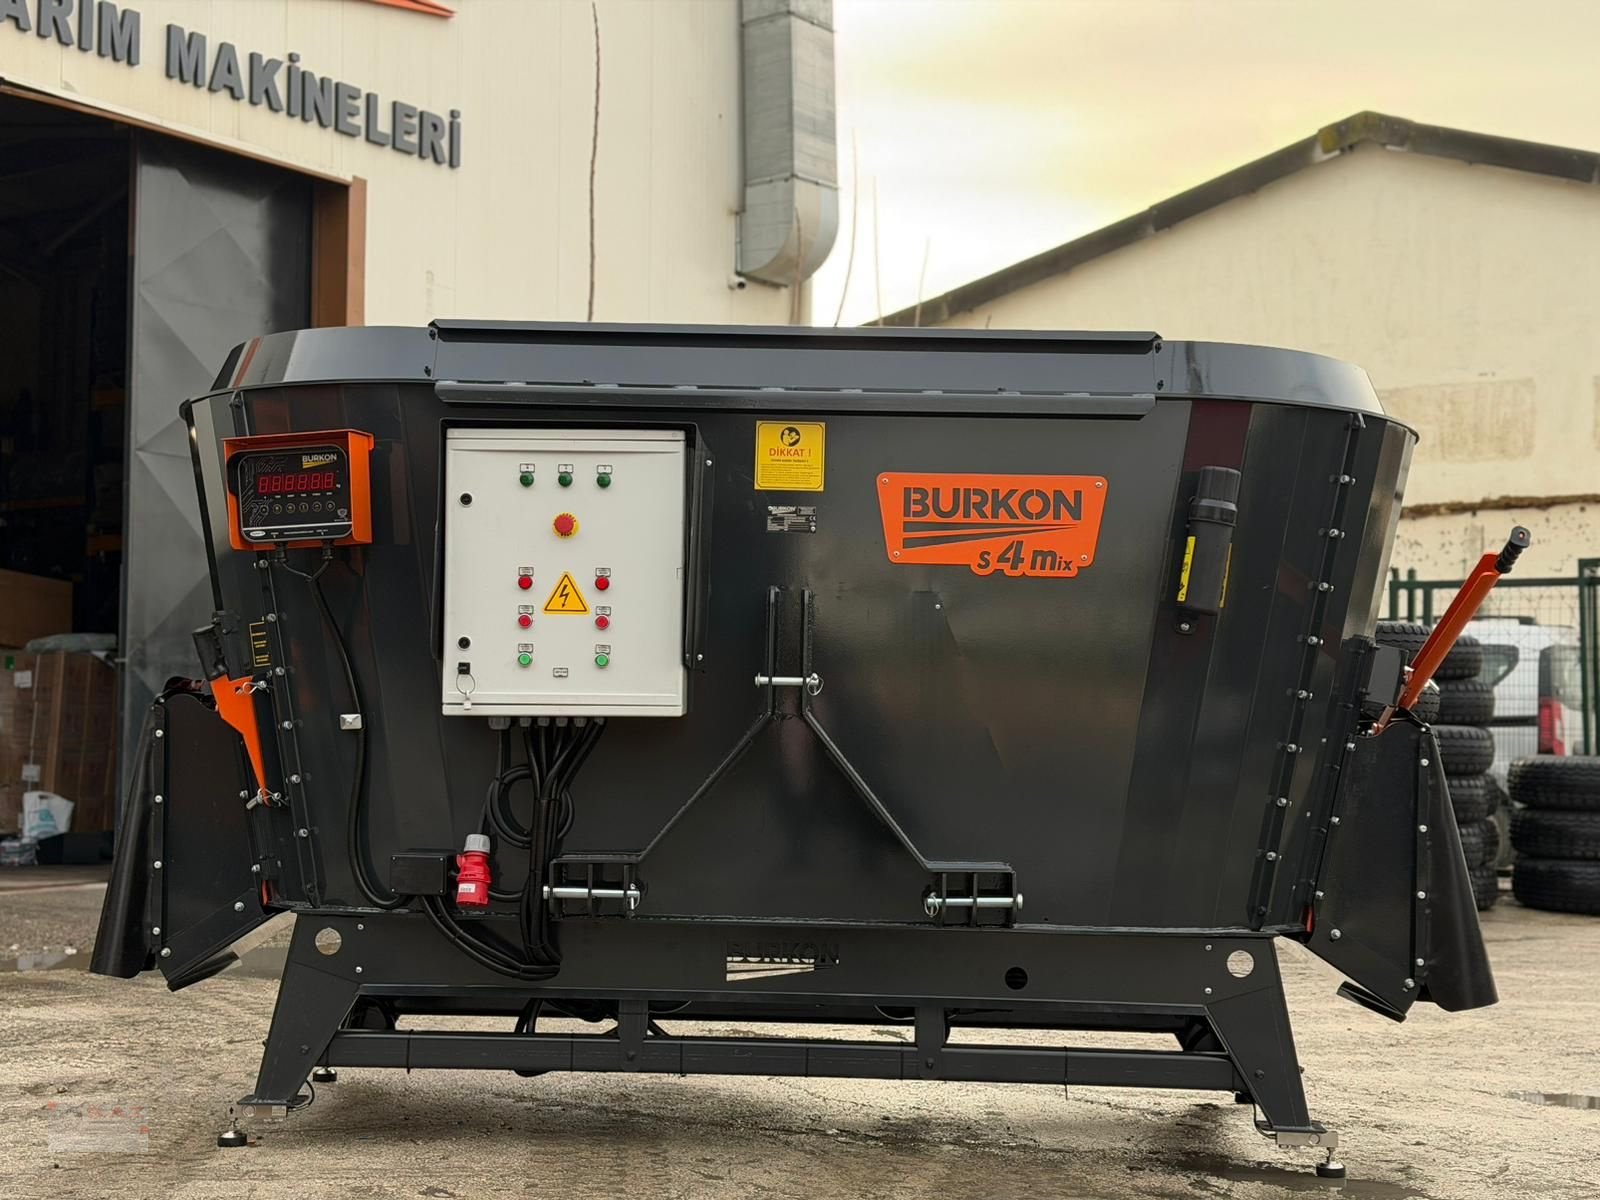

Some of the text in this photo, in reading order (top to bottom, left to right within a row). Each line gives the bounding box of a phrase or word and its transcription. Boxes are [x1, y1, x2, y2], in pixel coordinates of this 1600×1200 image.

[165, 23, 461, 169] MAKİNELERİ
[302, 453, 338, 463] BURKON
[769, 446, 806, 457] DİKKAT
[903, 486, 1083, 521] BURKON
